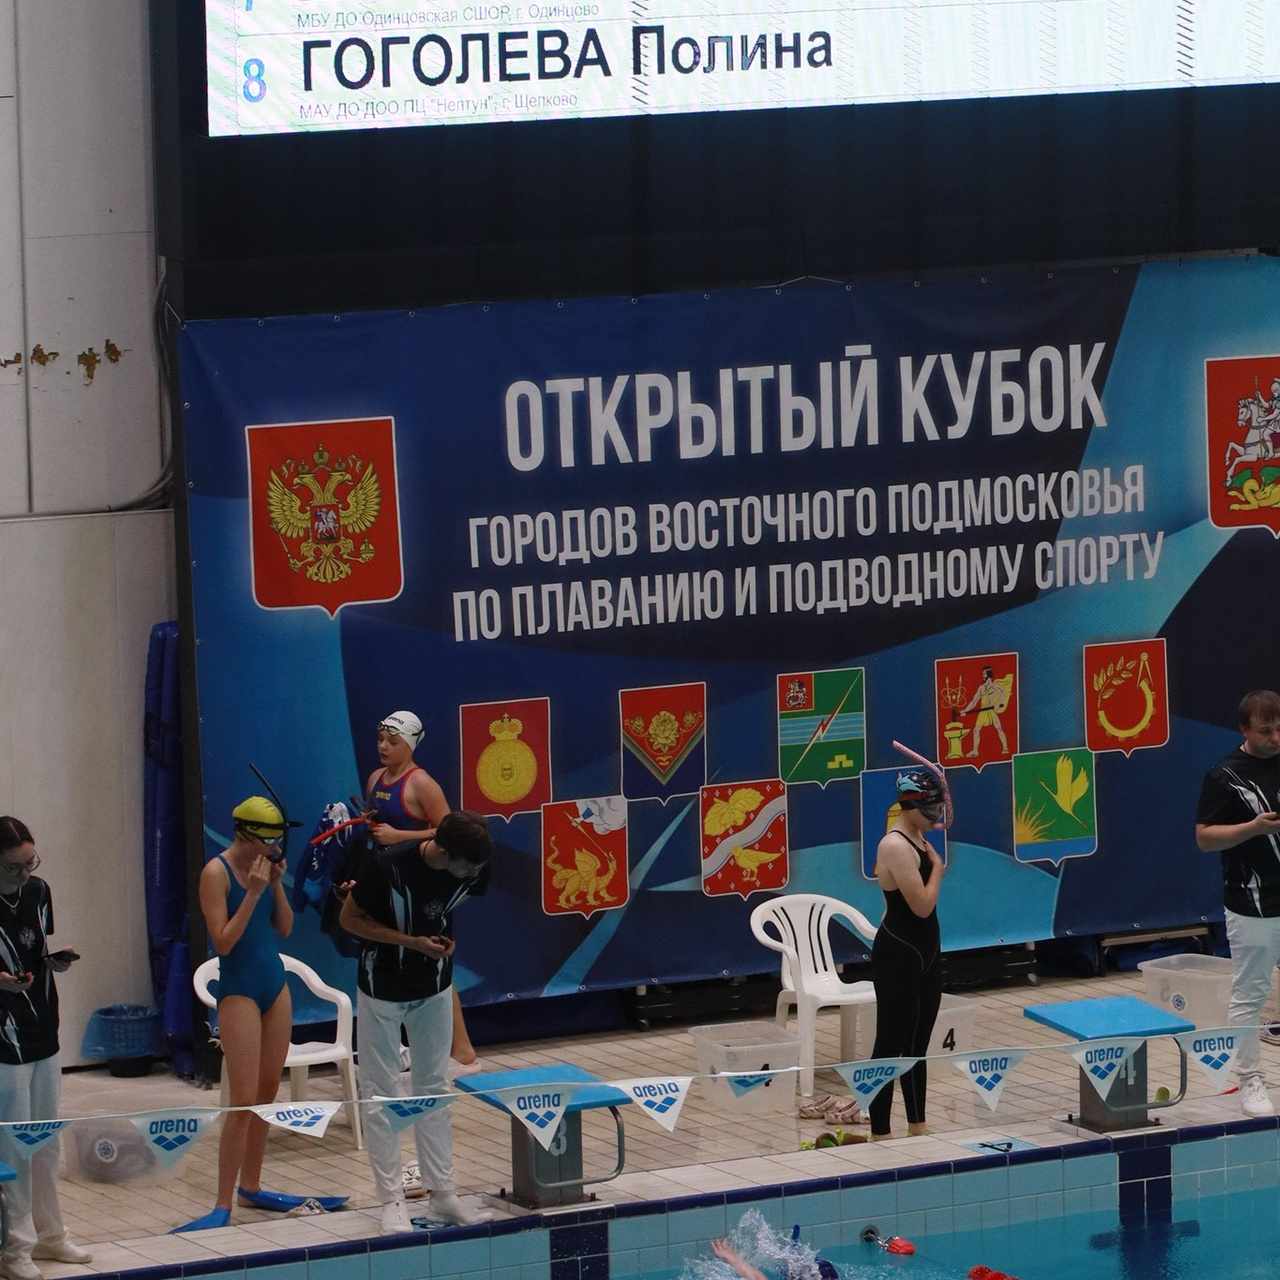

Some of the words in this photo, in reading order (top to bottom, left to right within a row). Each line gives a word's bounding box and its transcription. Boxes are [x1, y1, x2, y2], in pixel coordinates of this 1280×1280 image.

[296, 11, 331, 28] МБУ
[335, 10, 357, 27] ДО
[361, 7, 458, 26] Одинцовская
[528, 3, 600, 20] Одинцово
[242, 57, 267, 103] 8
[302, 28, 613, 92] ГОГОЛЕВА
[631, 25, 833, 76] Полина
[299, 102, 333, 119] МАУ
[336, 102, 360, 118] ДО
[363, 100, 400, 117] ДОО
[403, 99, 427, 116] ПЦ
[514, 95, 578, 111] Щелково
[504, 345, 880, 472] ОТКРЫТЫЙ
[899, 342, 1107, 443] КУБОК
[468, 505, 638, 568] ГОРОДОВ
[648, 487, 875, 554] ВОСТОЧНОГО
[887, 464, 1146, 536] ПОДМОСКОВЬЯ
[452, 589, 502, 642] ПО
[512, 568, 725, 639] ПЛАВАНИЮ
[734, 566, 757, 617] И
[768, 543, 1025, 615] ПОДВОДНОМУ
[1034, 531, 1165, 589] СПОРТУ
[942, 1028, 956, 1051] 4
[1193, 1036, 1235, 1053] arena
[1085, 1046, 1125, 1064] arena
[968, 1056, 1009, 1074] arena
[853, 1066, 895, 1083] arena
[632, 1081, 680, 1098] arena
[516, 1093, 561, 1111] arena
[275, 1106, 324, 1122] arena
[149, 1118, 198, 1136] arena
